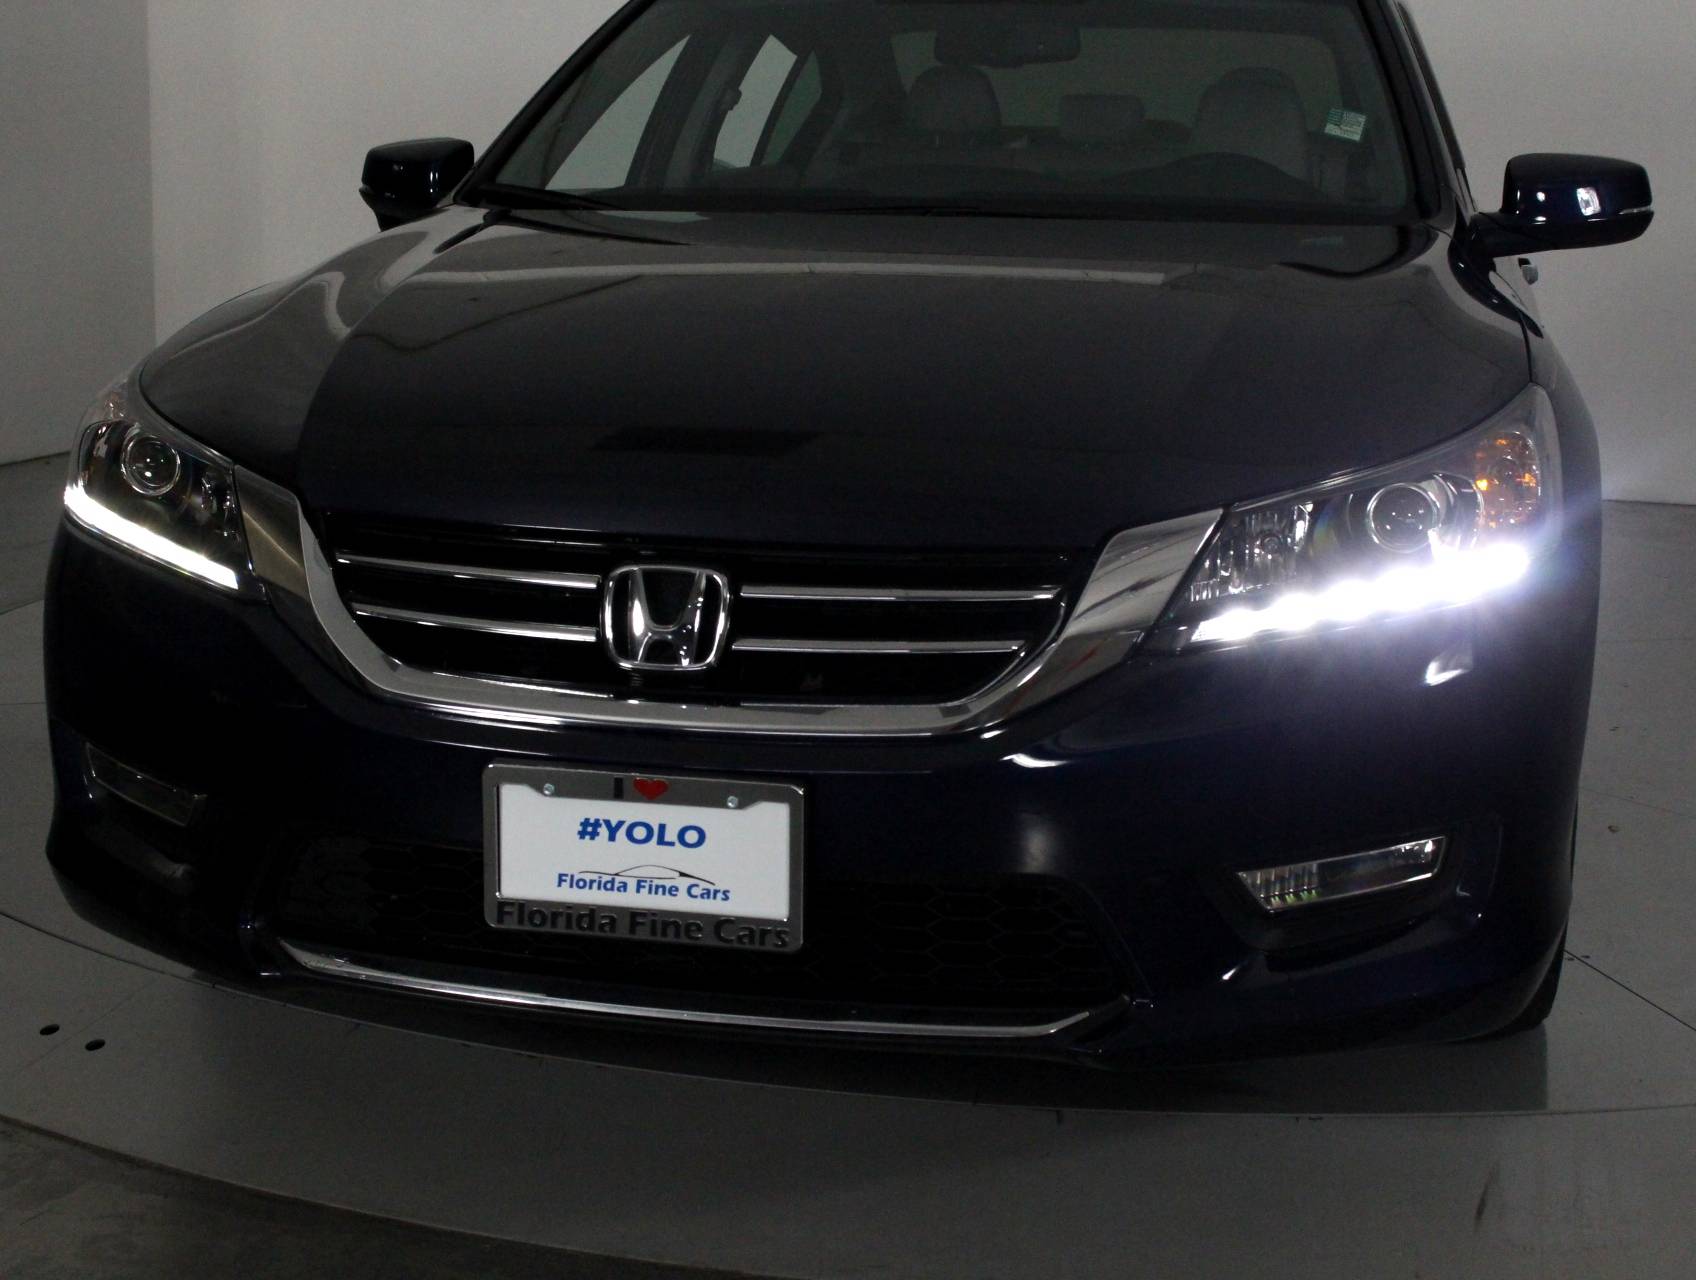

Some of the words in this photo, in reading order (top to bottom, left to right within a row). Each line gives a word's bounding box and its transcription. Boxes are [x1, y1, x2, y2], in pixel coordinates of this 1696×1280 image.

[613, 777, 624, 799] I
[577, 817, 706, 849] #YOLO
[556, 873, 628, 893] Florida
[636, 879, 679, 897] Fine
[686, 883, 730, 901] Cars
[496, 901, 617, 935] Florida
[629, 911, 703, 941] Fine
[714, 917, 790, 949] Cars
